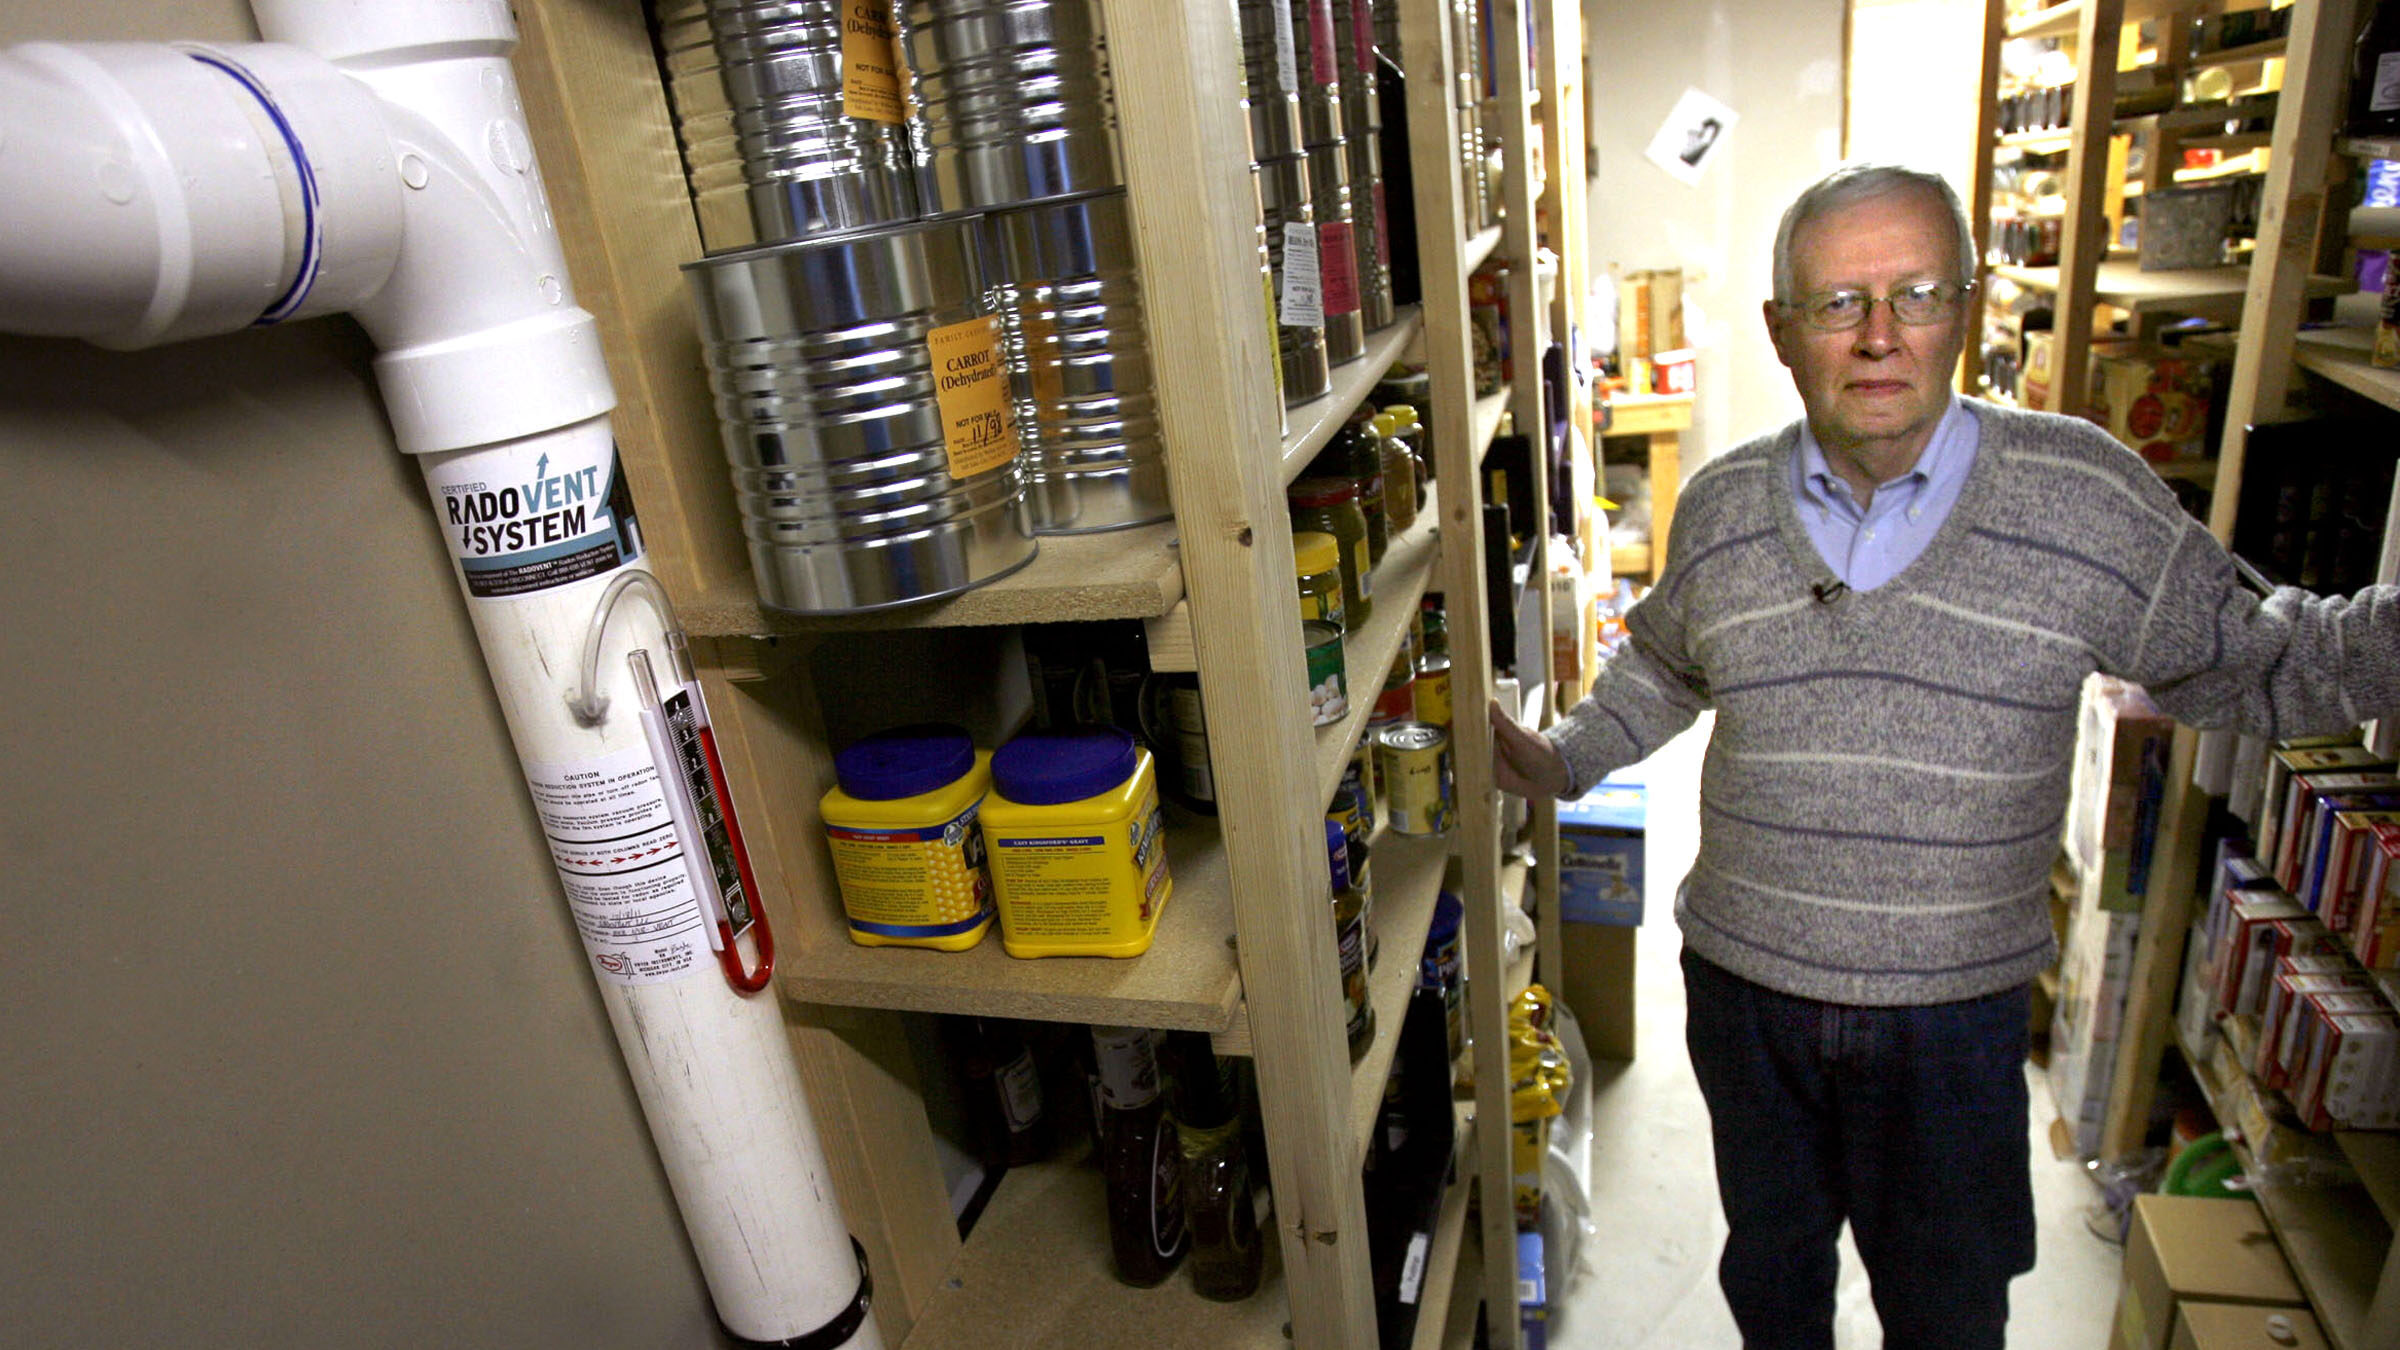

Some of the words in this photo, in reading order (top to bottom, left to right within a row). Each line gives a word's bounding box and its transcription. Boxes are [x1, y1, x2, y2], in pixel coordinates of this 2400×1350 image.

[946, 349, 990, 373] CARROT
[956, 418, 970, 428] NOT
[441, 481, 487, 495] CERTIFIED
[473, 505, 586, 556] SYSTEM
[564, 771, 600, 781] CAUTION
[579, 780, 606, 789] SYSTEM
[617, 766, 655, 781] OPERATION
[612, 843, 640, 853] COLUMNS
[642, 838, 657, 847] READ
[659, 832, 674, 841] ZERO
